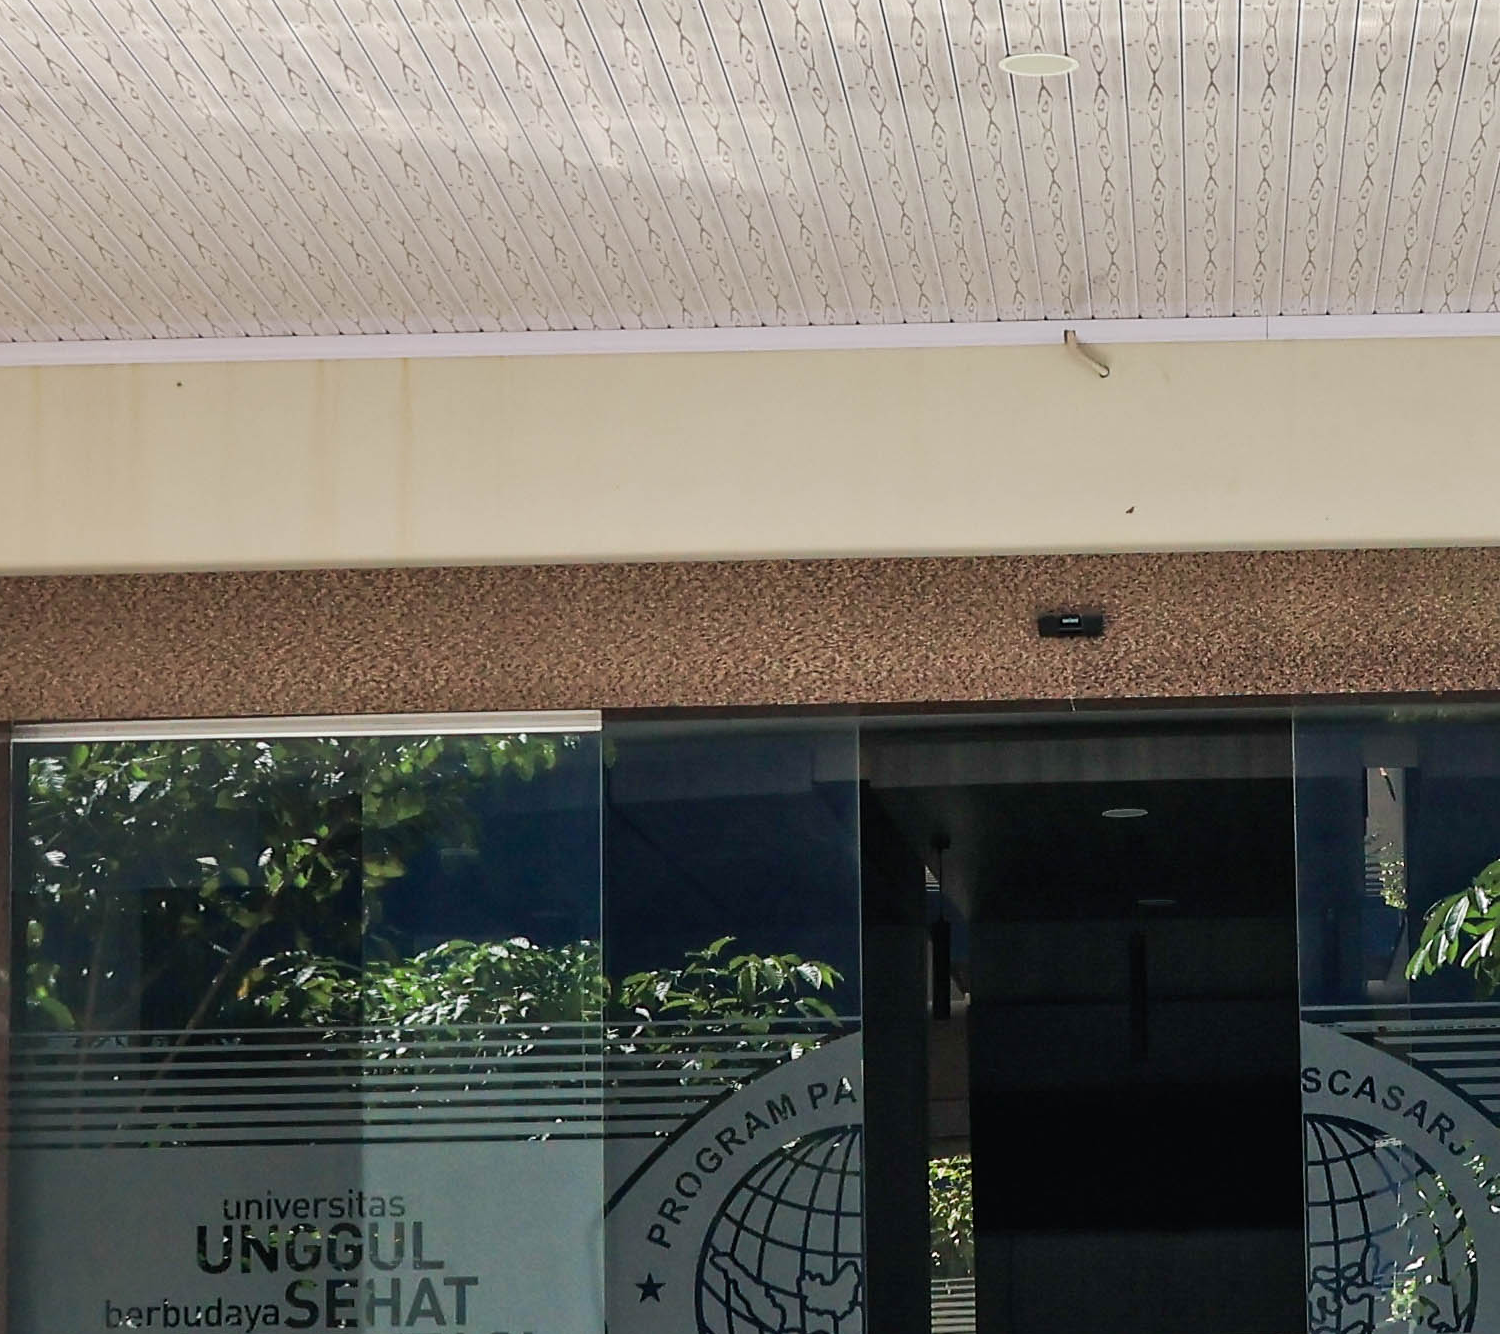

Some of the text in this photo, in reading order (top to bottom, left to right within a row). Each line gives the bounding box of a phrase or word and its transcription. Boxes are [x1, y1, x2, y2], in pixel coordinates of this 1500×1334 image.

[647, 1093, 797, 1250] PROGRAM
[222, 1190, 405, 1222] universitas
[197, 1221, 444, 1274] UNGGUL
[104, 1276, 478, 1334] berbudaya SEHAT
